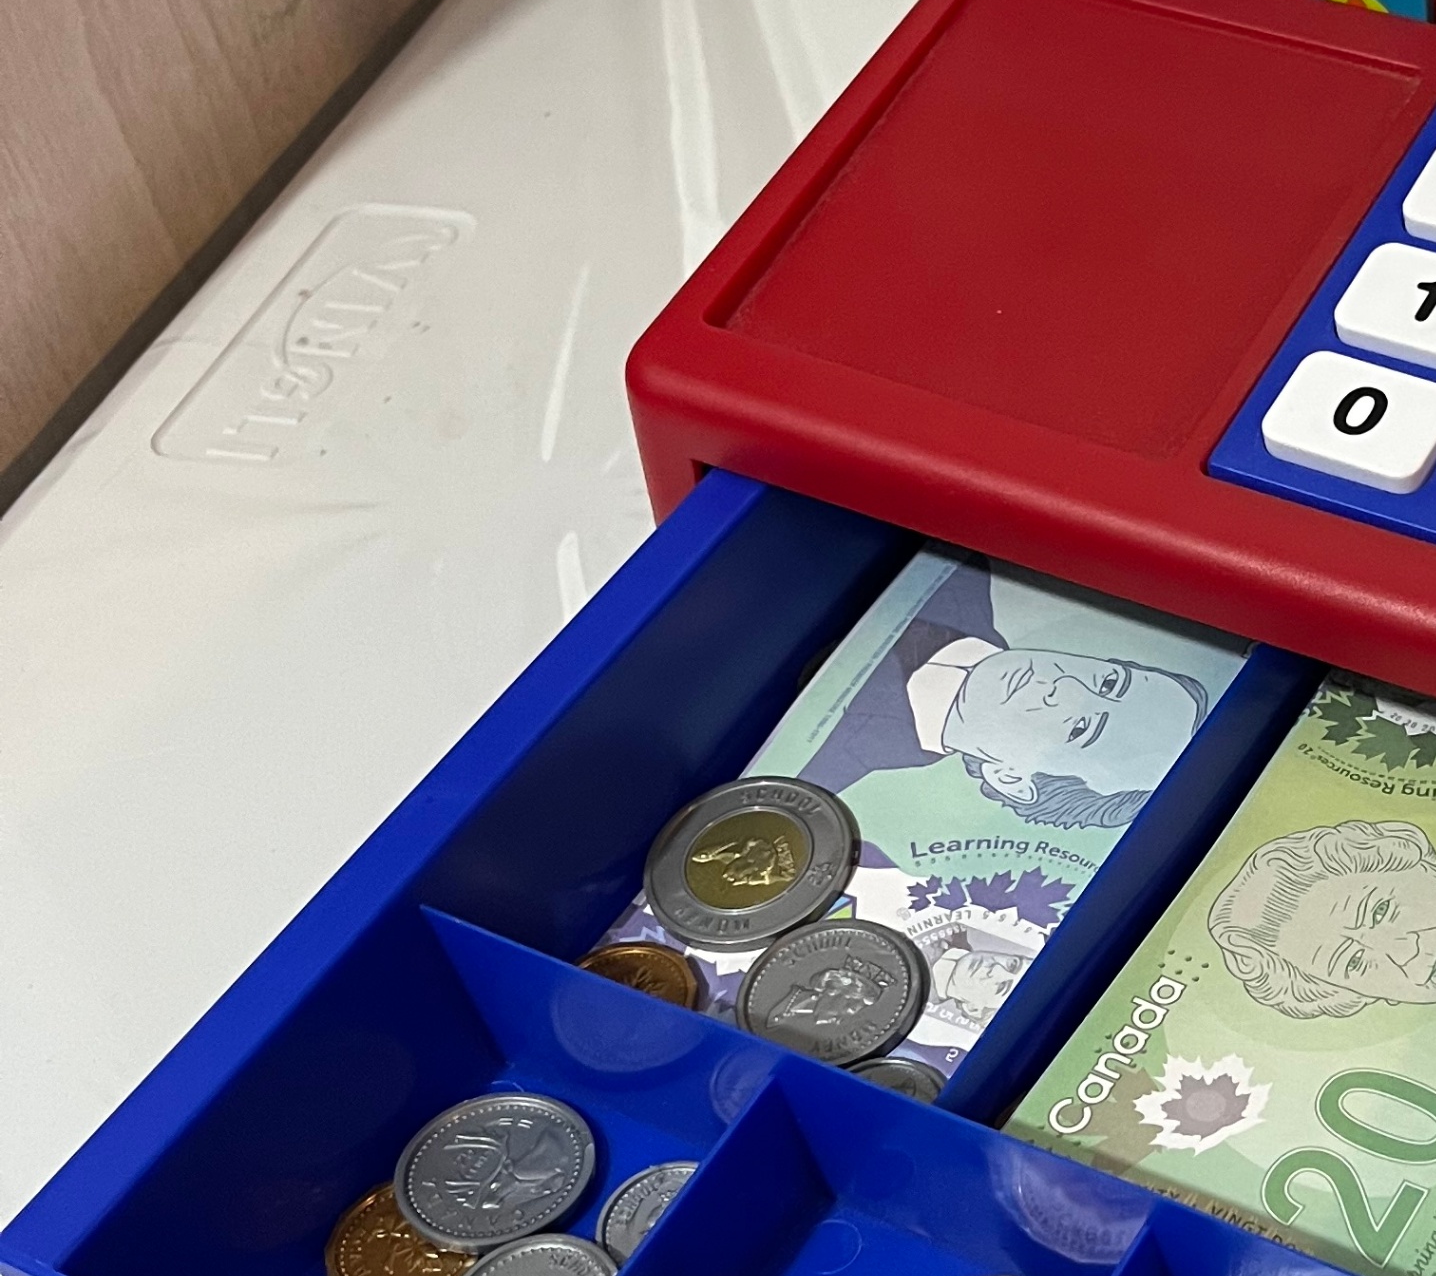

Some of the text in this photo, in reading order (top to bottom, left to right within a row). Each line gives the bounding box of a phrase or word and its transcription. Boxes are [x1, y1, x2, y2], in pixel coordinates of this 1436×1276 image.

[1332, 386, 1388, 435] 0
[910, 836, 1030, 860] Learning
[907, 910, 971, 936] LEARNIN
[1047, 975, 1186, 1136] Canada
